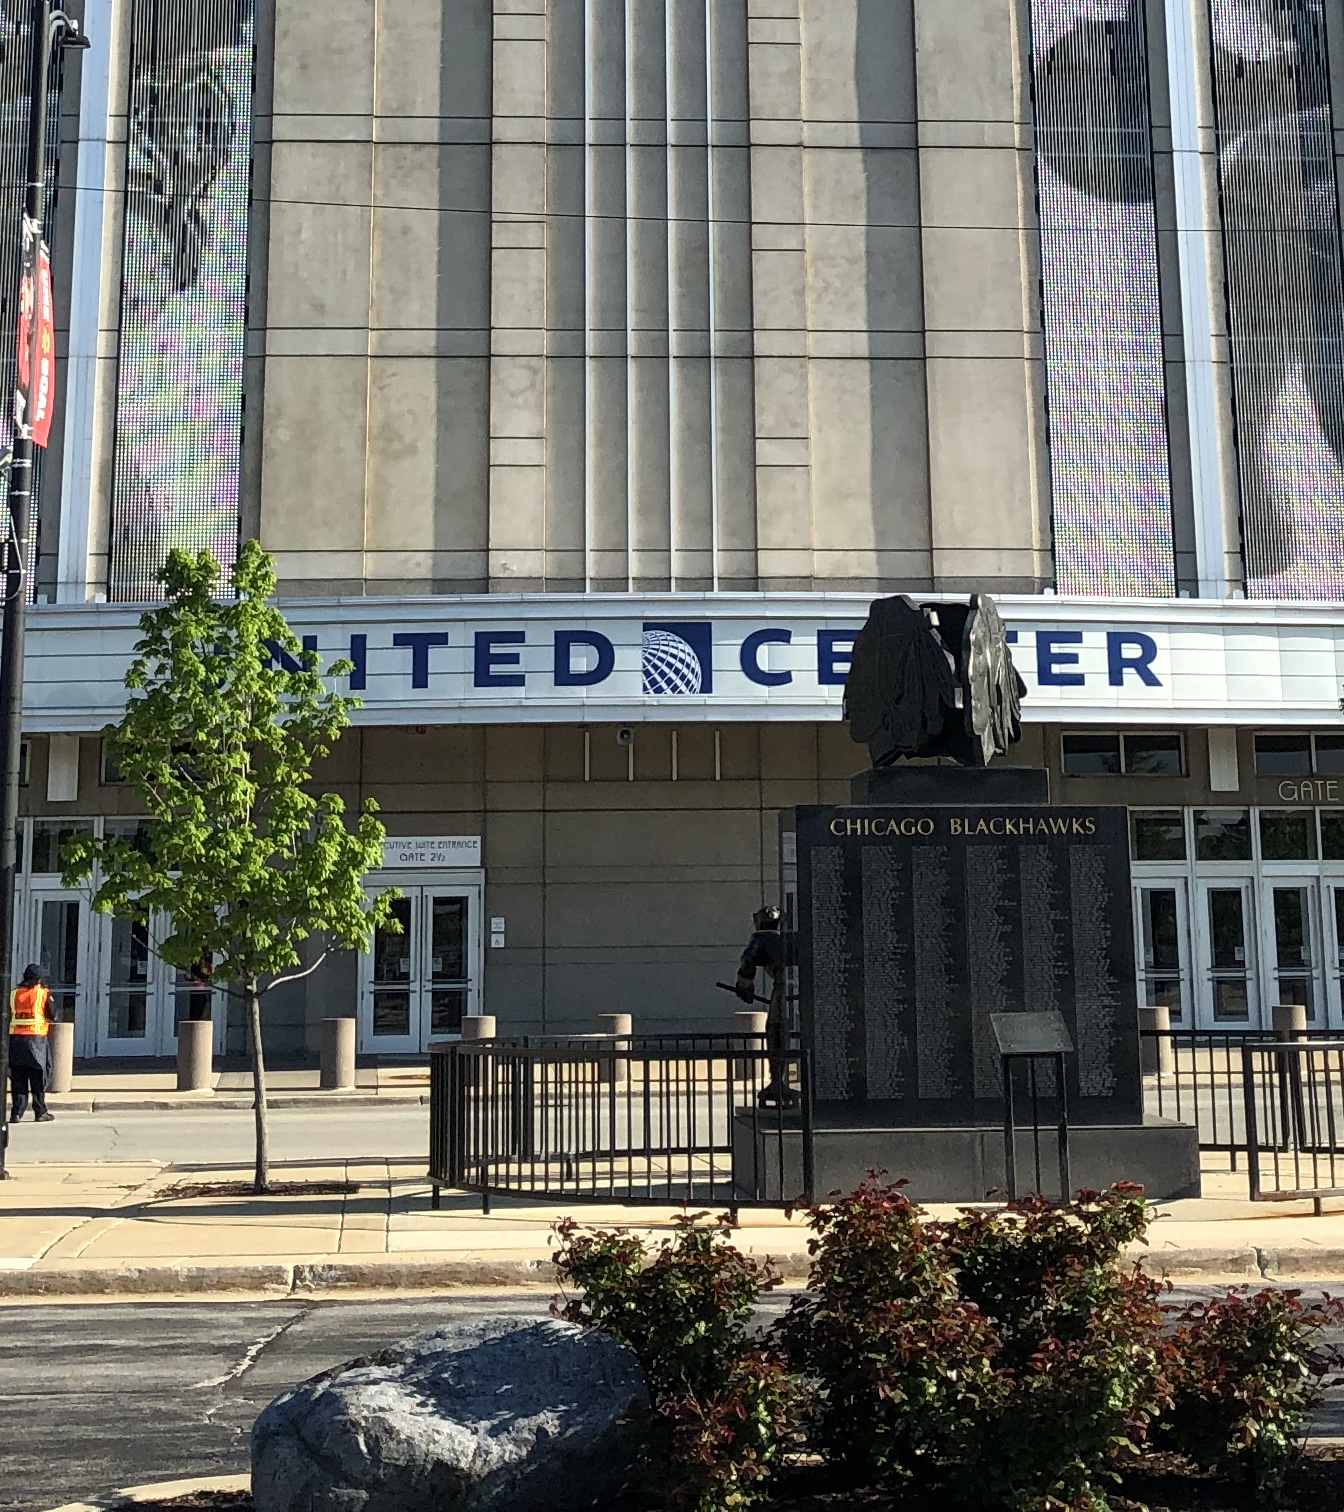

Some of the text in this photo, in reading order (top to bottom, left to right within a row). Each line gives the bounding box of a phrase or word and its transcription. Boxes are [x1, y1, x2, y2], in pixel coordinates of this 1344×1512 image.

[211, 628, 1163, 691] NITED CEER
[1278, 780, 1339, 801] GATE
[830, 817, 1096, 836] CHICAGO BLACKHAWKS
[438, 840, 477, 849] ENTRANCE
[399, 852, 426, 862] GATE
